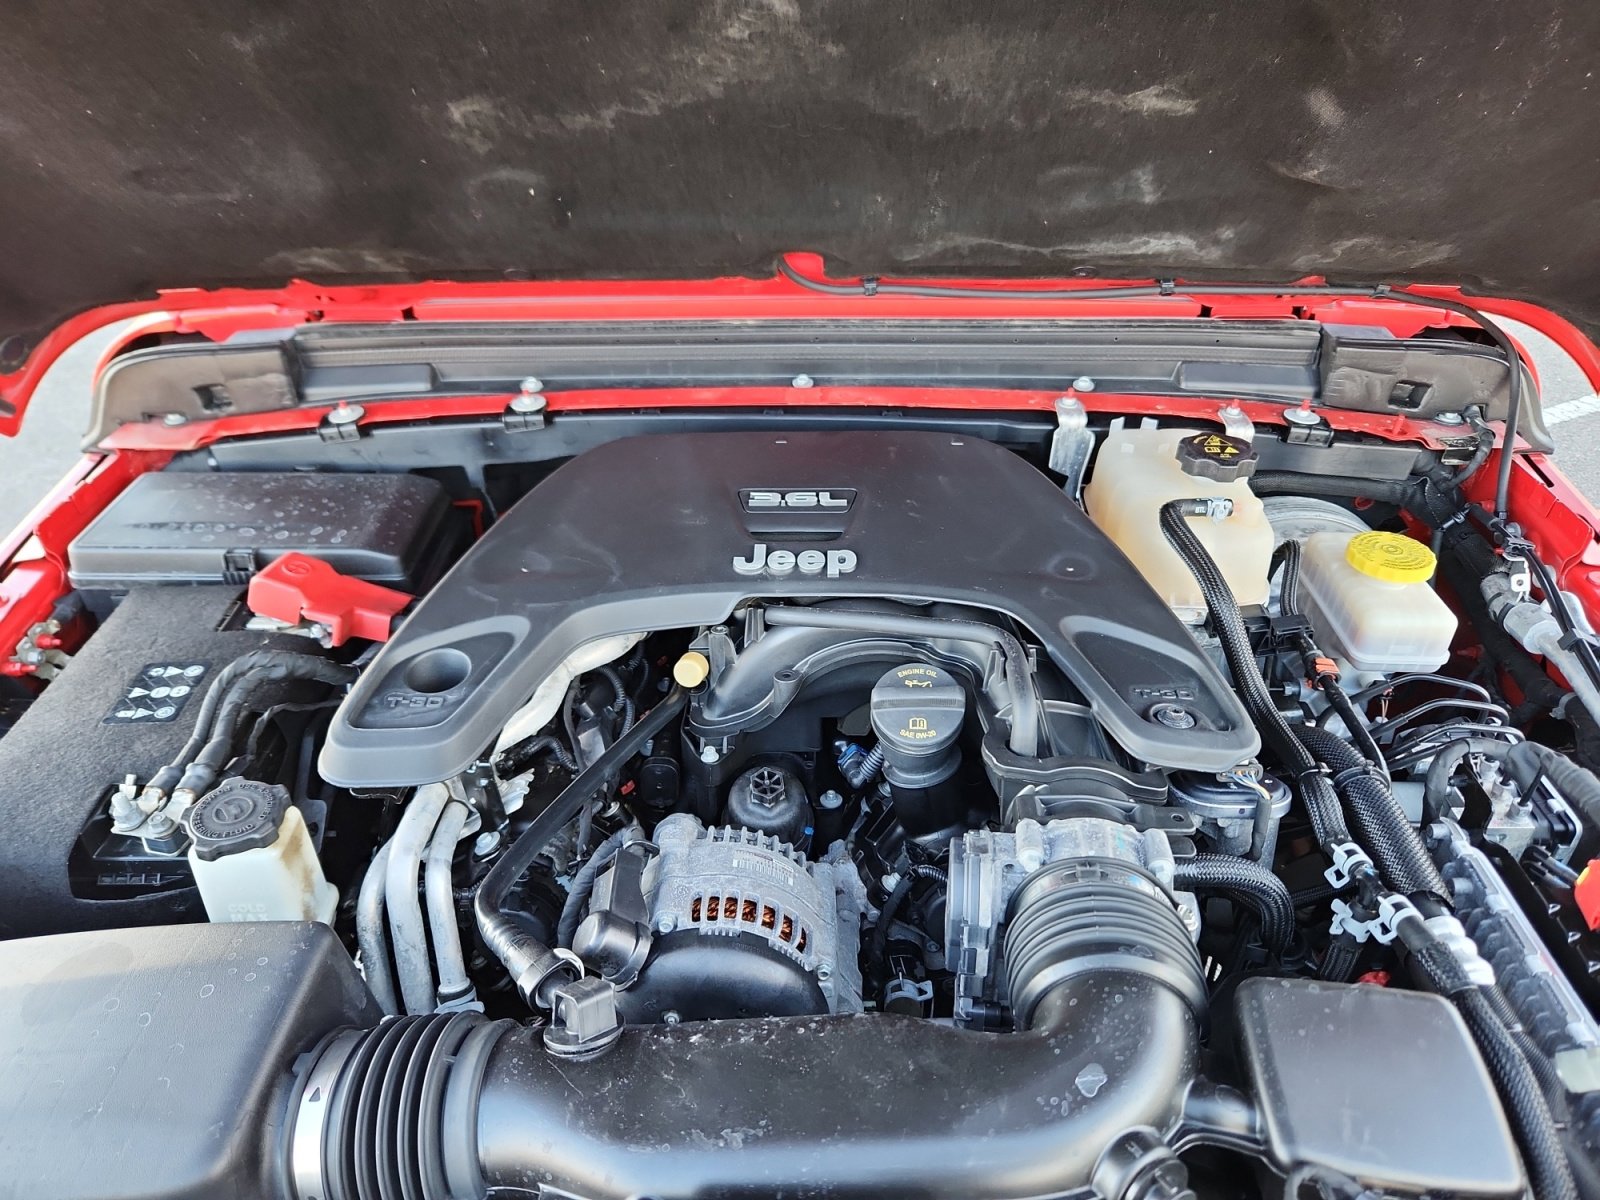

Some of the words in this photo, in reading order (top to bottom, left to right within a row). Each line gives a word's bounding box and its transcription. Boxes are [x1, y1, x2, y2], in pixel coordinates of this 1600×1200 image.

[748, 491, 848, 507] 3.6L
[732, 543, 858, 578] Jeep
[897, 668, 924, 678] ENGINE
[925, 668, 938, 678] OIL
[387, 696, 445, 708] T-30
[899, 729, 915, 739] SAE
[915, 729, 937, 739] 0W-20
[257, 786, 274, 820] APPROVED
[222, 823, 256, 838] FLUID
[228, 903, 266, 913] COLD
[230, 913, 269, 921] MAX
